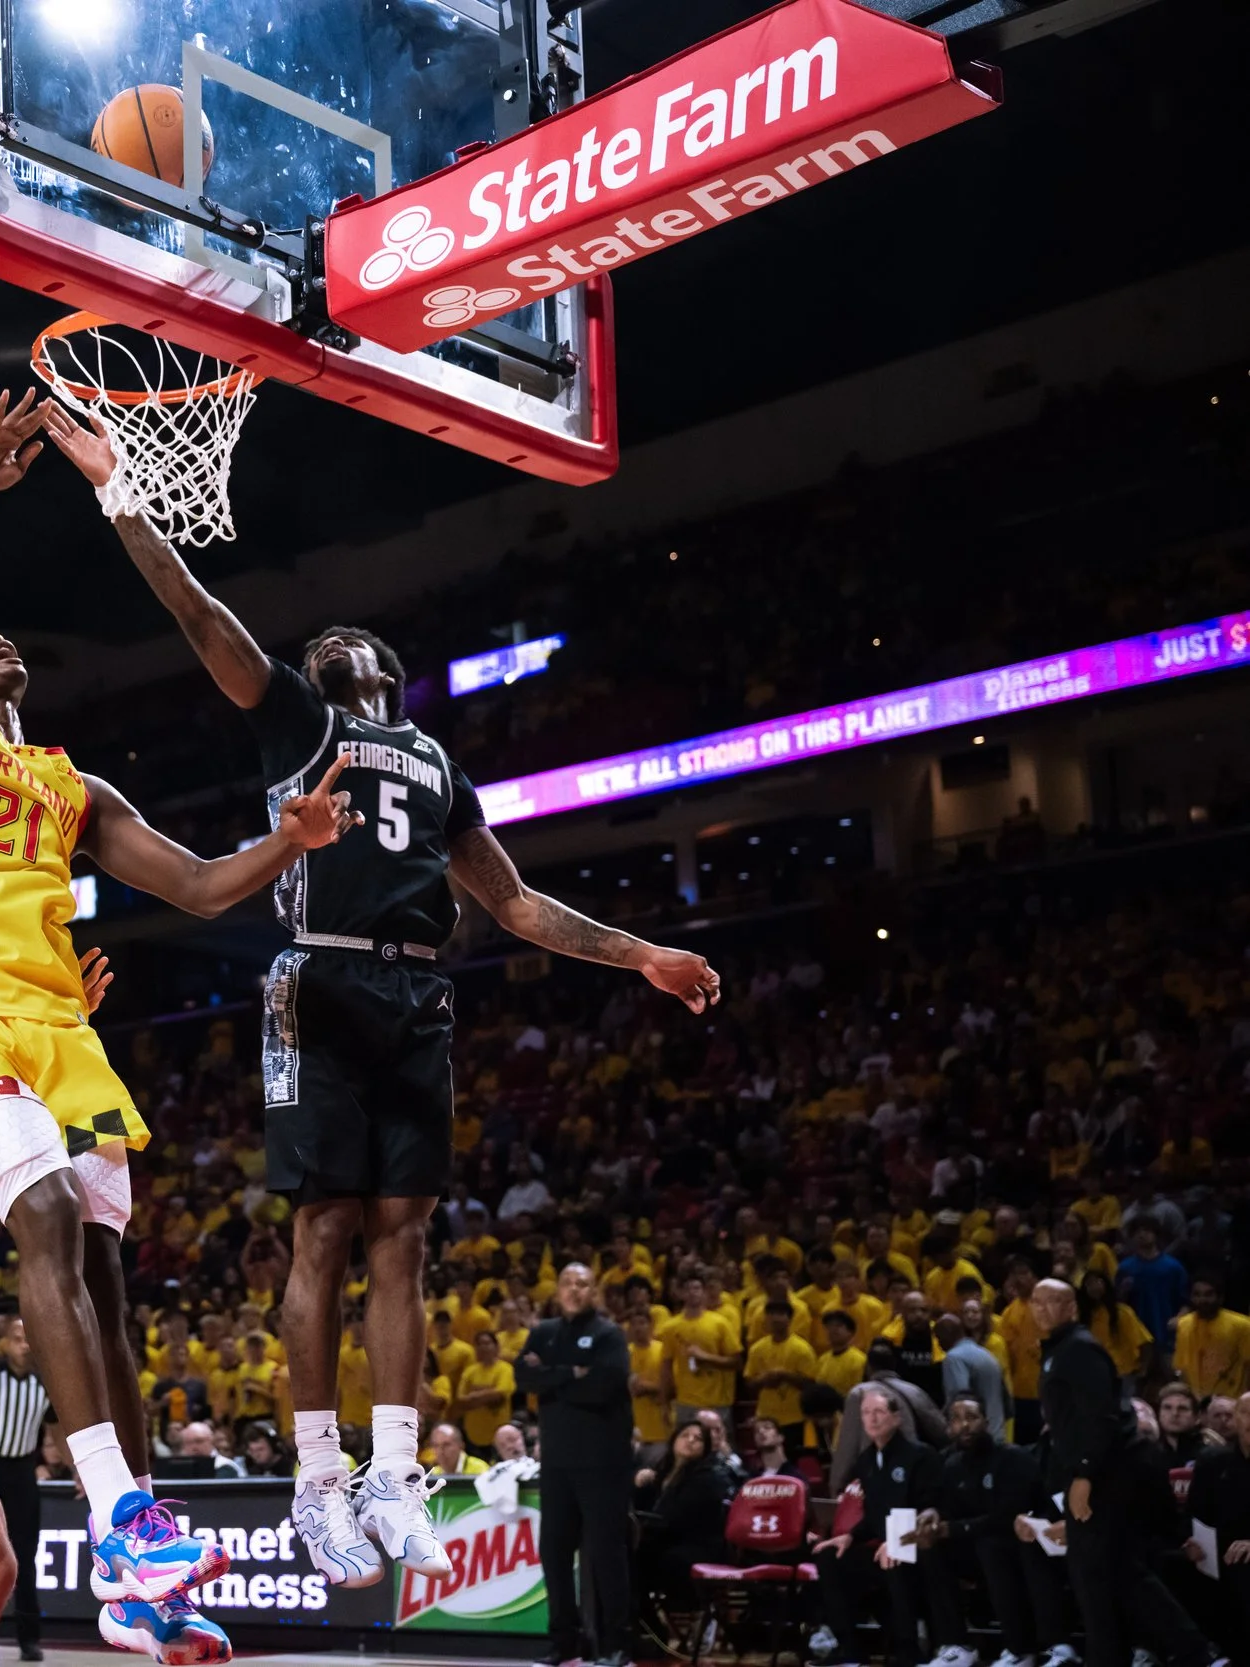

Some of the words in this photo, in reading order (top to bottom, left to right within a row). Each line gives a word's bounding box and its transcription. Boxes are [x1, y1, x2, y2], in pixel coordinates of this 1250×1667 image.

[1154, 628, 1222, 669] JUST
[983, 657, 1069, 701] planet
[997, 672, 1090, 712] fitness
[639, 756, 677, 785] ALL
[678, 736, 756, 777] STRONG
[759, 729, 790, 758] ON
[792, 717, 842, 749] THIS
[844, 696, 930, 739] PLANET
[337, 740, 442, 797] GEORGETOWN
[377, 779, 410, 853] 5
[741, 1484, 798, 1499] MARYLAND
[187, 1573, 328, 1610] tness
[399, 1517, 541, 1622] LIBMA
